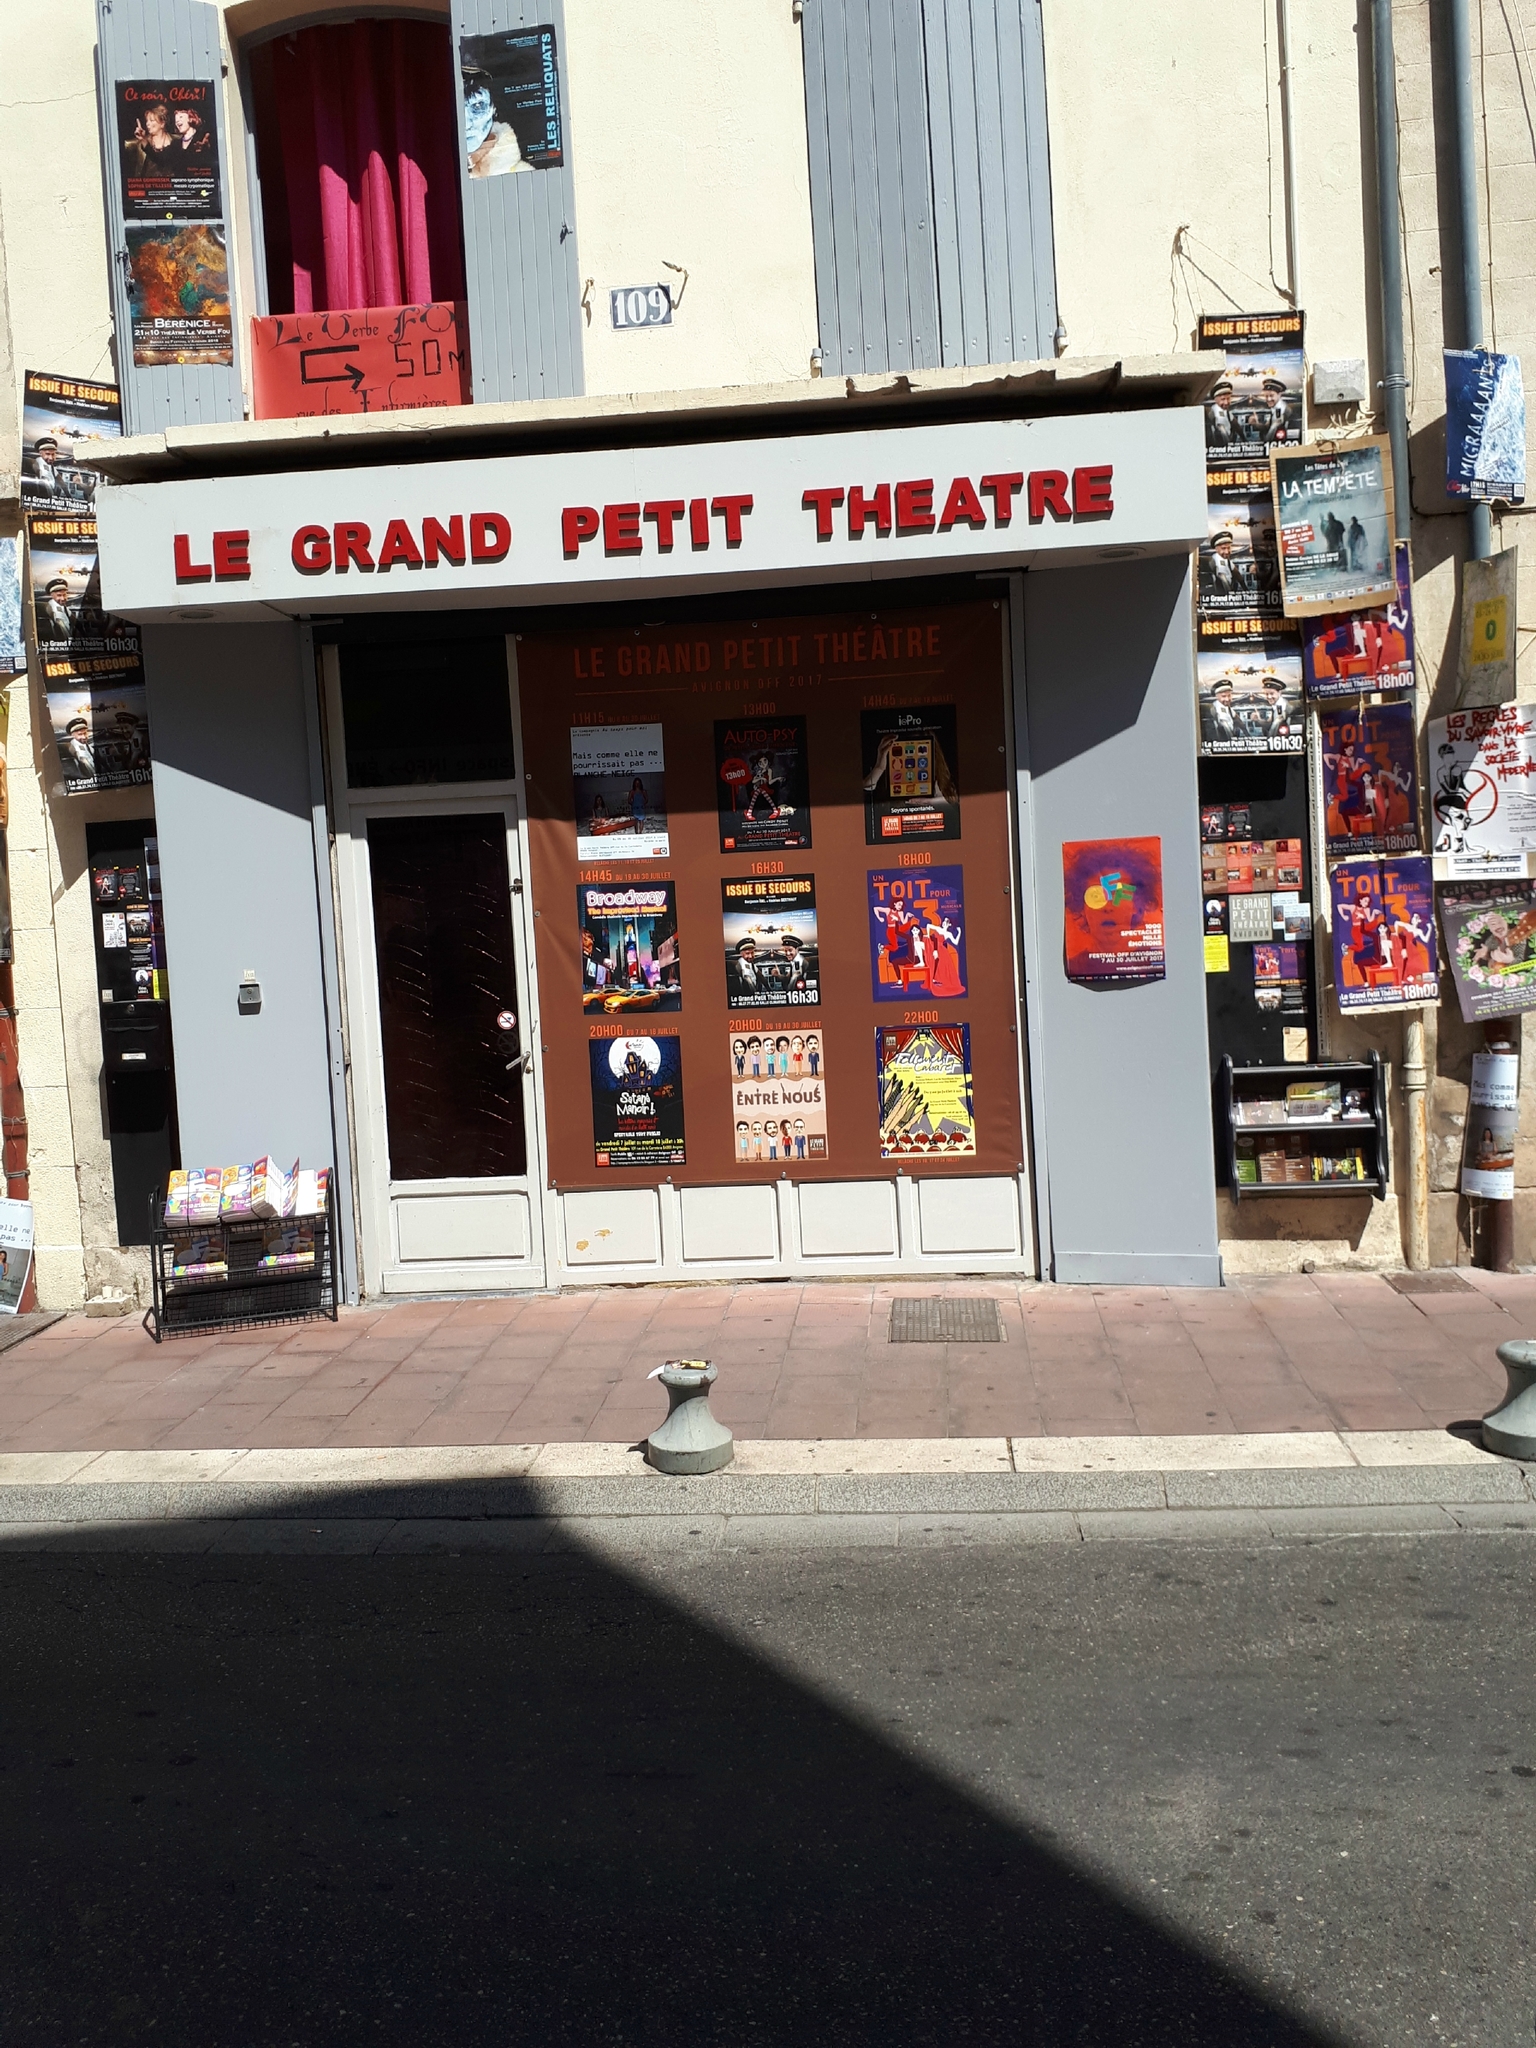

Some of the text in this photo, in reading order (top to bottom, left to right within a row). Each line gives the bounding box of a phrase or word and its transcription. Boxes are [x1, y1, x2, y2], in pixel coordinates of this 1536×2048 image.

[125, 87, 139, 101] Ce
[542, 33, 557, 149] LES RELIQUATS
[614, 288, 668, 326] 109
[154, 318, 211, 328] BÉRÉNICE
[1203, 317, 1301, 336] ISSUE DE SECOURS
[29, 377, 61, 393] ISSUE
[62, 384, 76, 396] DE
[1235, 472, 1249, 484] DE
[1282, 470, 1378, 498] LA TEMPÊTE
[32, 496, 50, 504] Grand
[51, 498, 65, 506] Petit
[66, 500, 88, 509] Théâtre
[33, 522, 80, 534] ISSUE DE
[174, 465, 1114, 581] LE GRAND PETIT THEATRE
[1202, 593, 1265, 602] Le Grand Petit Théâtre
[1202, 619, 1297, 635] ISSUE DE SECOURS
[104, 637, 138, 651] 16h30
[572, 623, 943, 679] LE GRAND PETIT THÉÂTRE
[46, 656, 140, 677] ISSUE DE SECOURS
[691, 673, 823, 694] AVIGNON OFF 2017
[1319, 683, 1338, 691] Grand
[1338, 681, 1352, 689] Petit
[1353, 679, 1376, 688] Théâtre
[1376, 671, 1414, 689] 18h00
[862, 693, 896, 708] 14H45
[743, 701, 776, 715] 13H00
[572, 711, 604, 724] 11H15
[1446, 713, 1466, 728] LES
[723, 727, 798, 744] AUTO-PSY
[1323, 721, 1382, 747] TOIT
[1447, 730, 1462, 743] DU
[1245, 738, 1268, 746] Théâtre
[1267, 736, 1301, 750] 16h30
[1504, 737, 1517, 748] LA
[572, 752, 592, 760] Mais
[596, 751, 620, 759] comme
[624, 749, 644, 757] elle
[573, 759, 645, 770] pourrissait pas
[94, 775, 108, 783] Petit
[108, 773, 129, 782] Théâtre
[725, 768, 746, 780] 13h00
[1385, 834, 1417, 850] 18h00
[897, 851, 931, 866] 18H00
[751, 861, 784, 875] 16H30
[579, 869, 613, 882] 14H45
[650, 871, 671, 879] JUILLET
[726, 880, 812, 897] ISSUE DE SECOURS
[873, 879, 931, 900] TOIT
[1336, 873, 1399, 898] TOIT
[1397, 883, 1420, 892] POUR
[586, 889, 666, 906] Broadway
[929, 889, 951, 898] POUR
[1232, 897, 1269, 910] LE GRAND
[913, 898, 942, 935] 3
[1232, 909, 1269, 920] PETIT
[1381, 893, 1411, 933] 3
[1233, 929, 1269, 938] AVIGNON
[786, 989, 819, 1004] 16h30
[1402, 982, 1438, 1000] 18h00
[904, 1010, 939, 1024] 22H00
[590, 1024, 678, 1037] 20H00 DU JUILLET
[729, 1018, 762, 1032] 20H00
[800, 1020, 822, 1028] JUILLET
[737, 1087, 822, 1106] ENTRE NOUS
